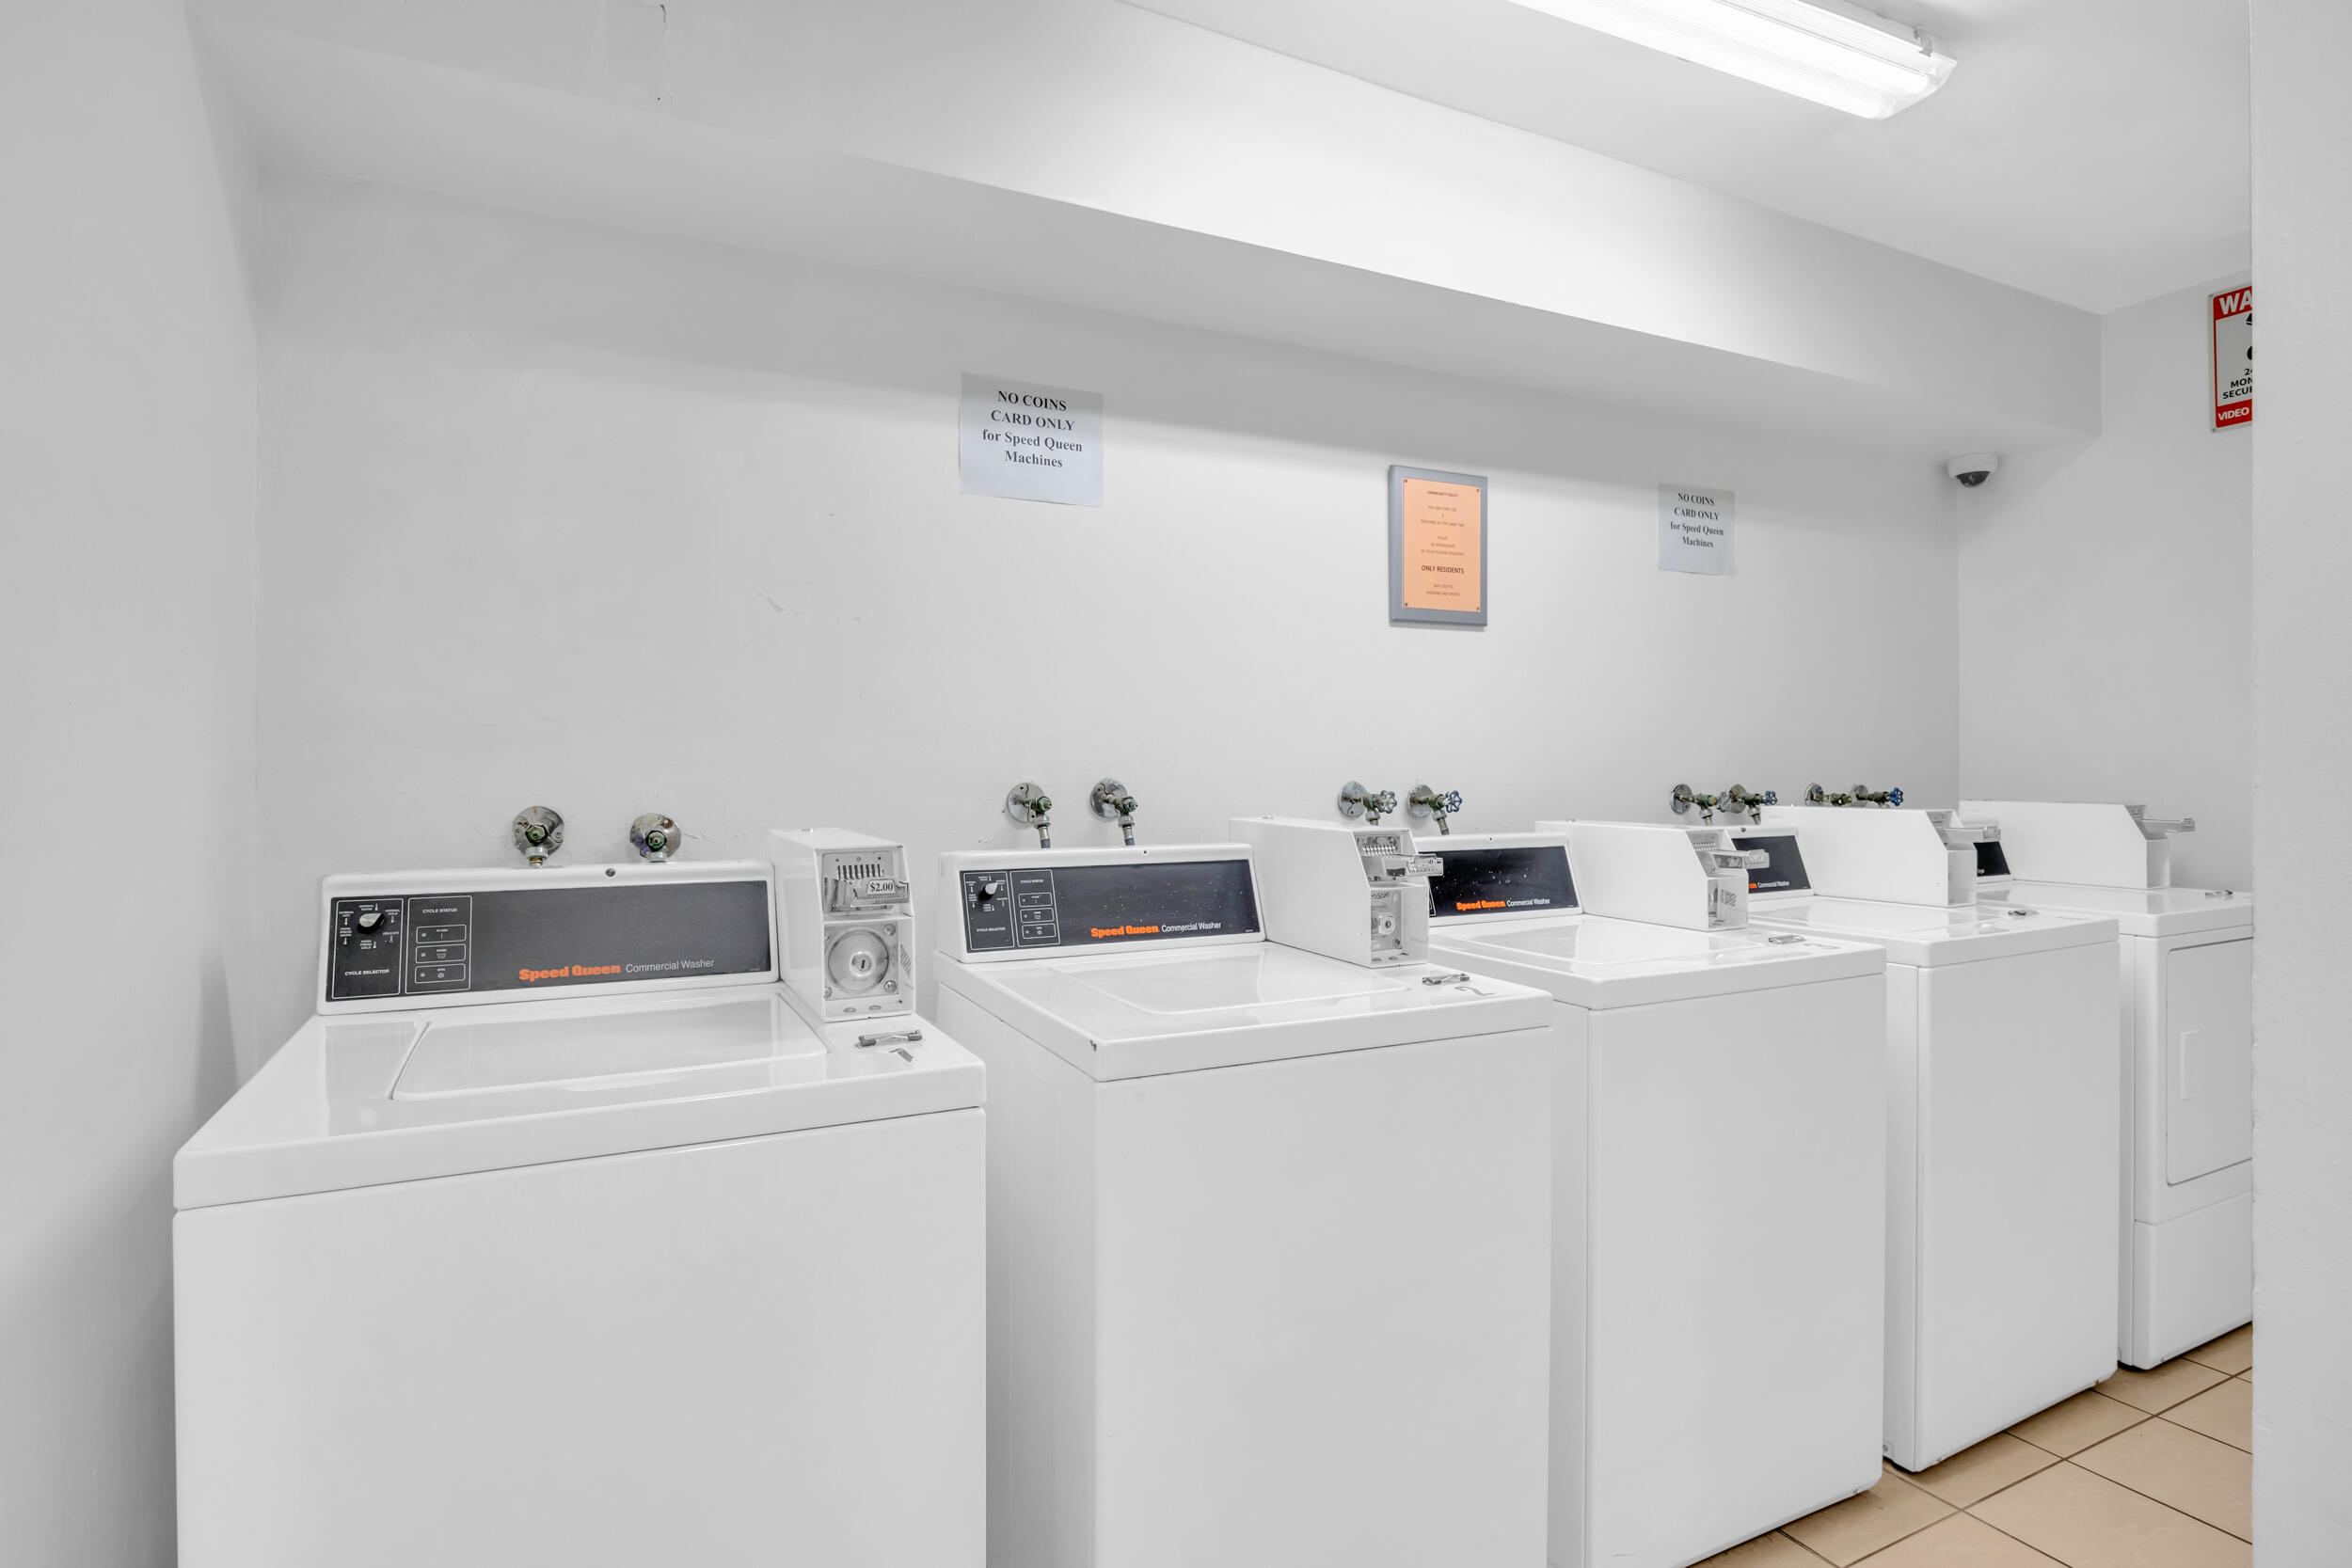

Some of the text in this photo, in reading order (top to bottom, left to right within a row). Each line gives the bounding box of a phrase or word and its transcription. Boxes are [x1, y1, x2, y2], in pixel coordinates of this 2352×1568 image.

[997, 390, 1067, 411] NO COINS
[991, 409, 1075, 431] CARD ONLY
[2217, 406, 2249, 420] VIDEO
[982, 429, 1083, 452] for Speed Queen
[1004, 450, 1063, 467] Machines
[1677, 492, 1715, 505] NO COINS
[1674, 507, 1719, 520] CARD ONLY
[1670, 521, 1724, 535] for Speed Queen
[1682, 536, 1714, 547] Machines
[1437, 565, 1465, 574] RESIDENTS
[869, 882, 894, 892] $2.00
[1456, 901, 1481, 911] Speed
[1481, 900, 1506, 909] Queen
[1506, 898, 1533, 907] Commercial
[1090, 926, 1124, 939] Speed
[1125, 925, 1159, 935] Queen
[1161, 922, 1198, 933] Commercial
[518, 958, 715, 982] Speed Queen Commercial Washer
